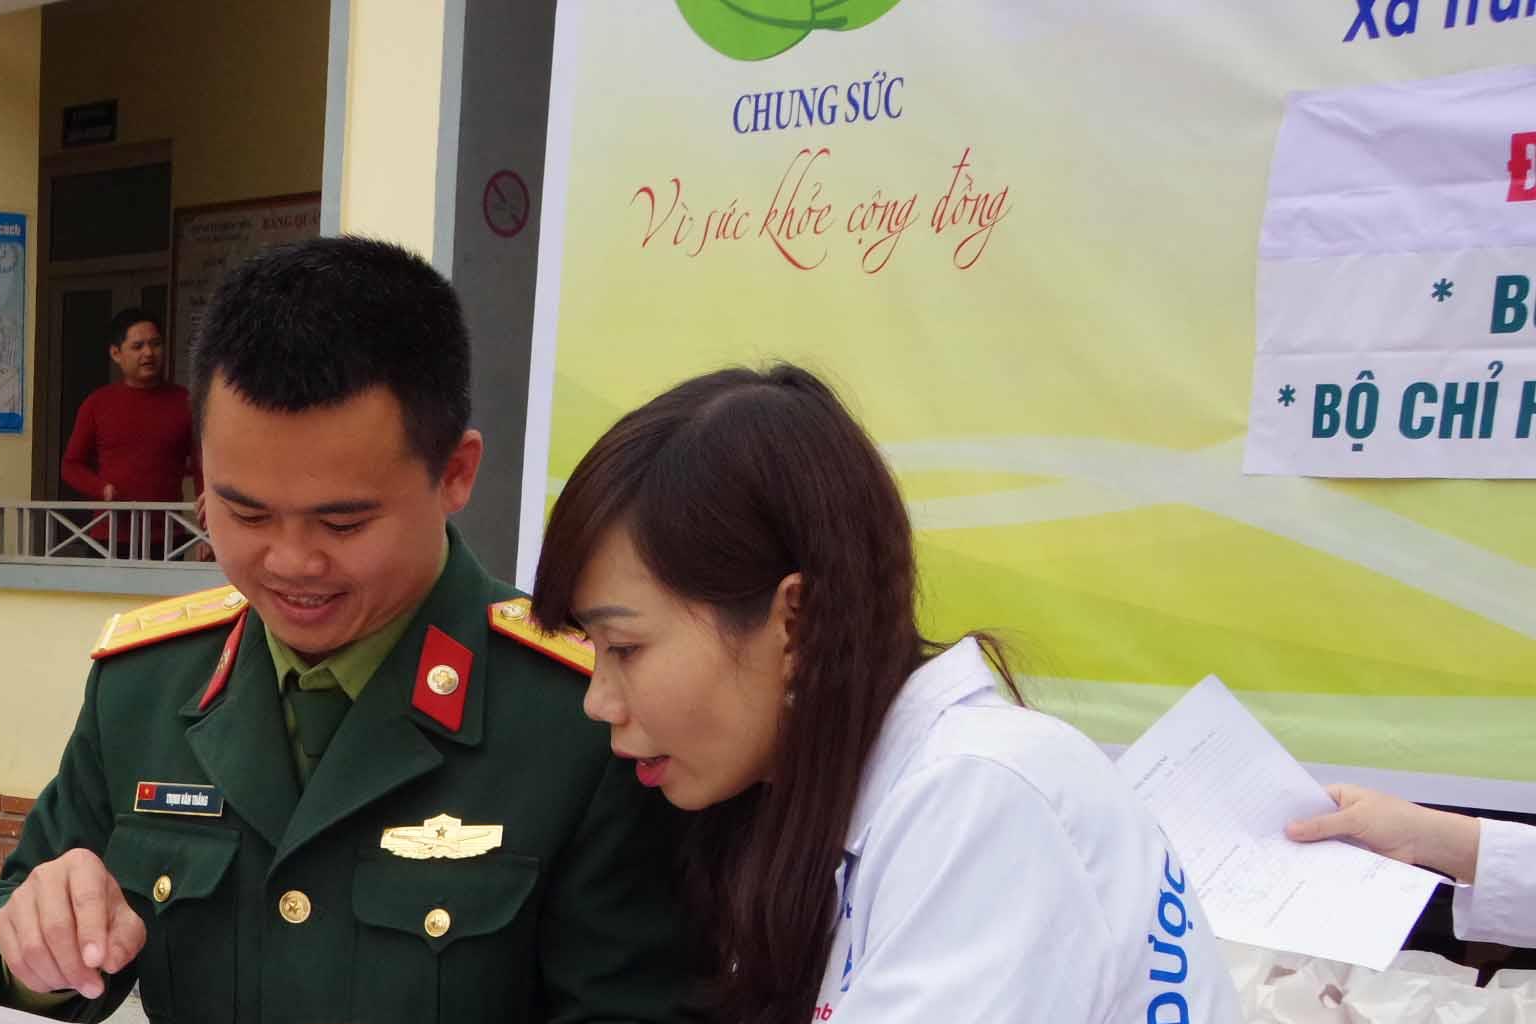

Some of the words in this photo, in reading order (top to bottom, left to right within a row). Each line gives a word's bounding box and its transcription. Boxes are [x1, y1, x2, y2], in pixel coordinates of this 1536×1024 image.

[732, 84, 839, 134] CHUNG
[845, 71, 905, 123] SỨC
[630, 176, 695, 248] Vì
[686, 198, 751, 258] sức
[847, 188, 920, 274] cộng
[931, 146, 1013, 270] đồng
[1312, 369, 1380, 452] BỘ
[1399, 360, 1504, 440] CHỈ
